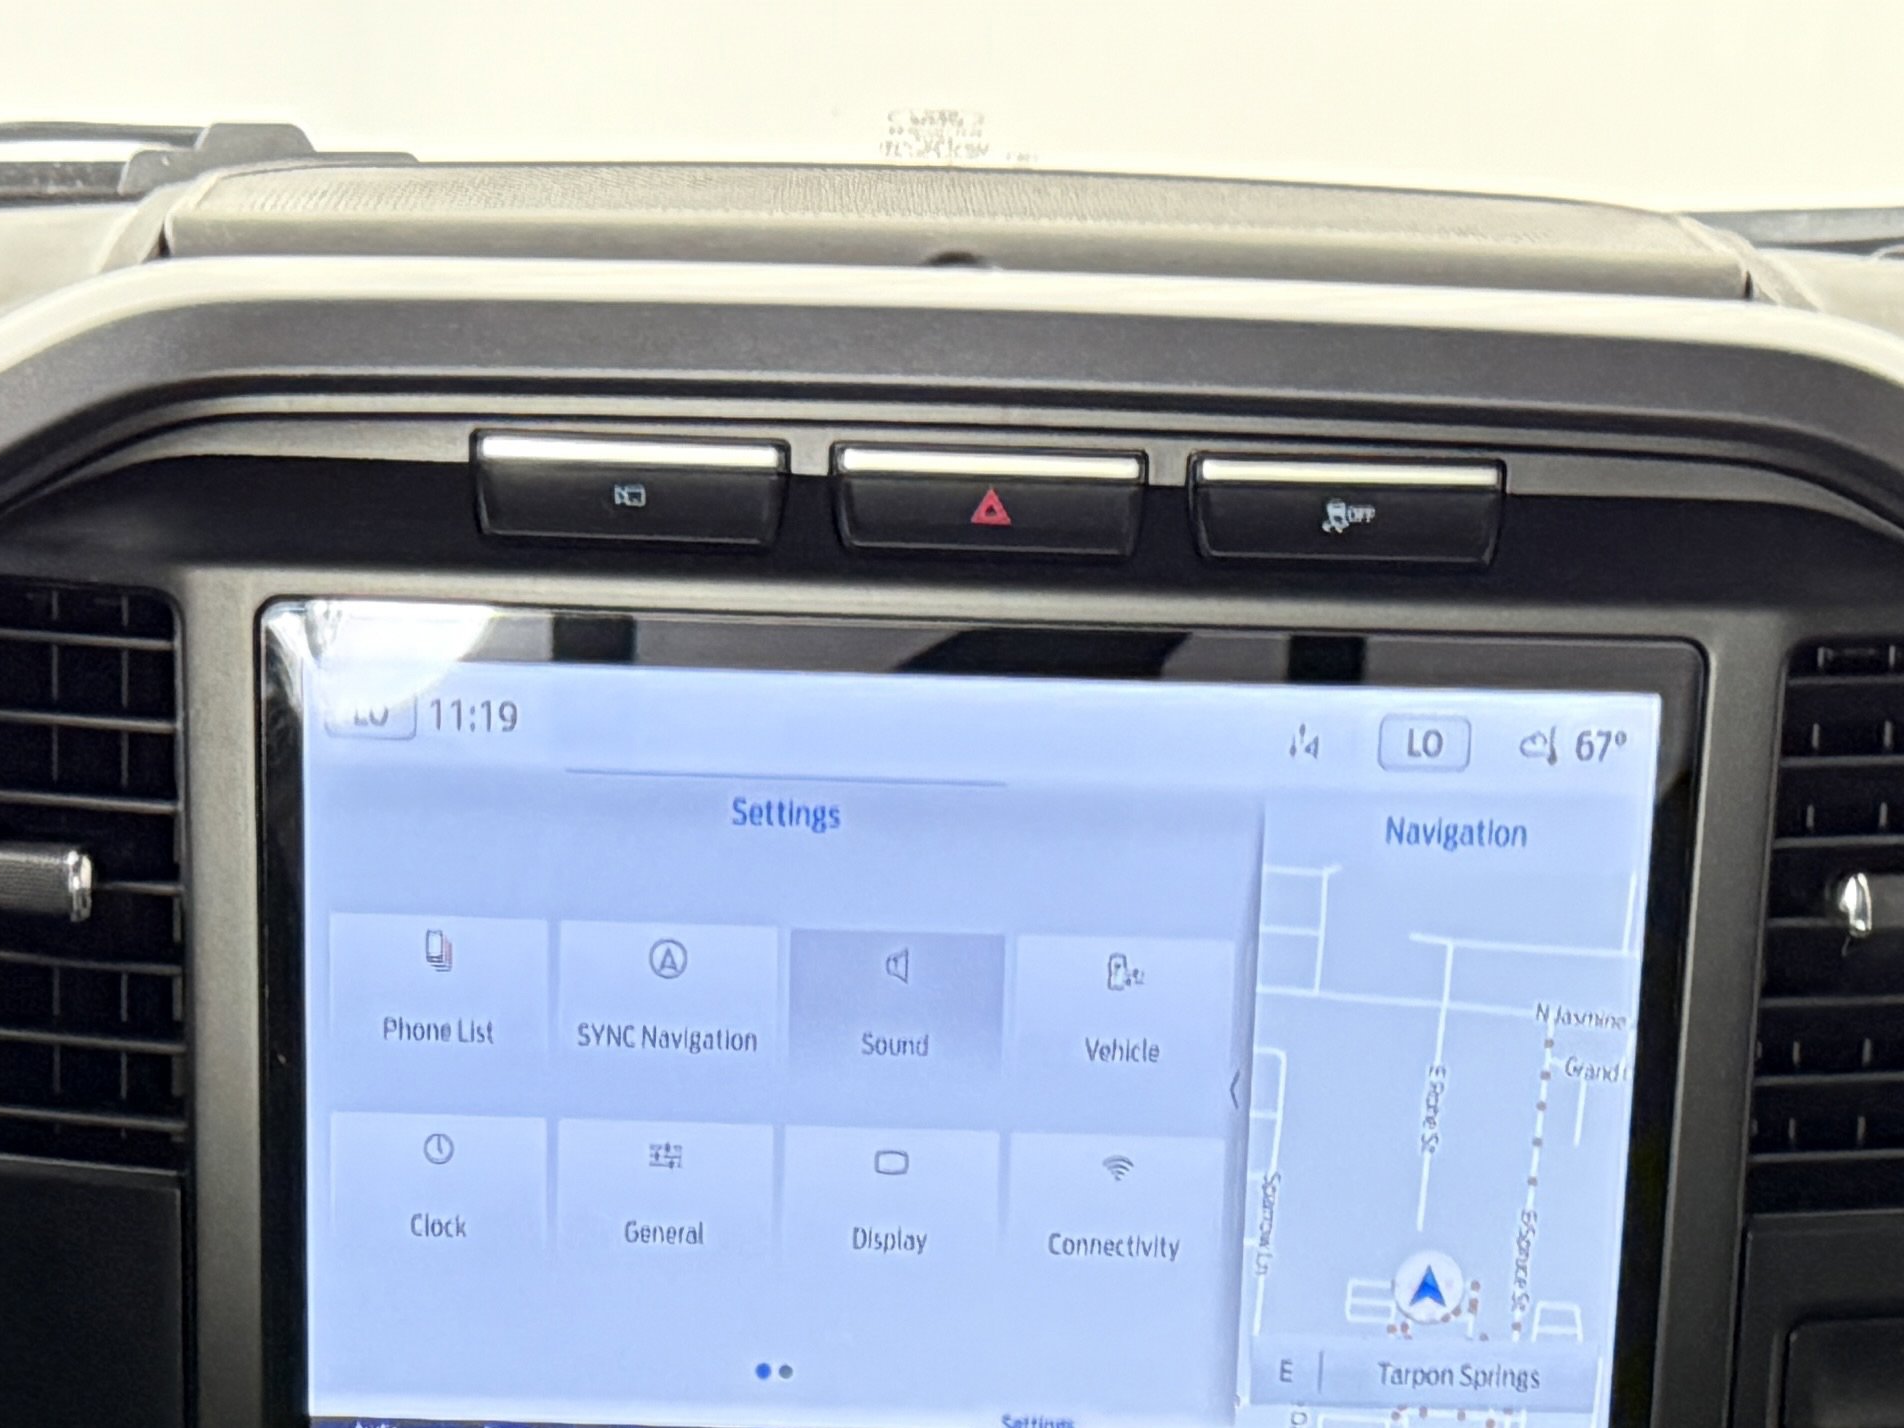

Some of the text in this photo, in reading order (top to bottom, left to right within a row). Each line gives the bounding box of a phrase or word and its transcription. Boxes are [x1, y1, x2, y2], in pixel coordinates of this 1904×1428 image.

[1347, 505, 1376, 523] OFF
[430, 698, 518, 732] 11:19
[1406, 727, 1444, 758] LO
[730, 796, 842, 834] Settings
[1384, 815, 1528, 852] Navigation
[382, 1017, 495, 1046] Phone List
[576, 1022, 759, 1058] SYNC Navigation
[861, 1029, 930, 1058] Sound
[1084, 1036, 1161, 1065] Vehicle
[409, 1212, 468, 1240] Clock
[623, 1219, 706, 1246] General
[851, 1225, 929, 1257] Display
[1047, 1231, 1181, 1263] Connectivity
[1279, 1358, 1541, 1394] E Tarpon Springs
